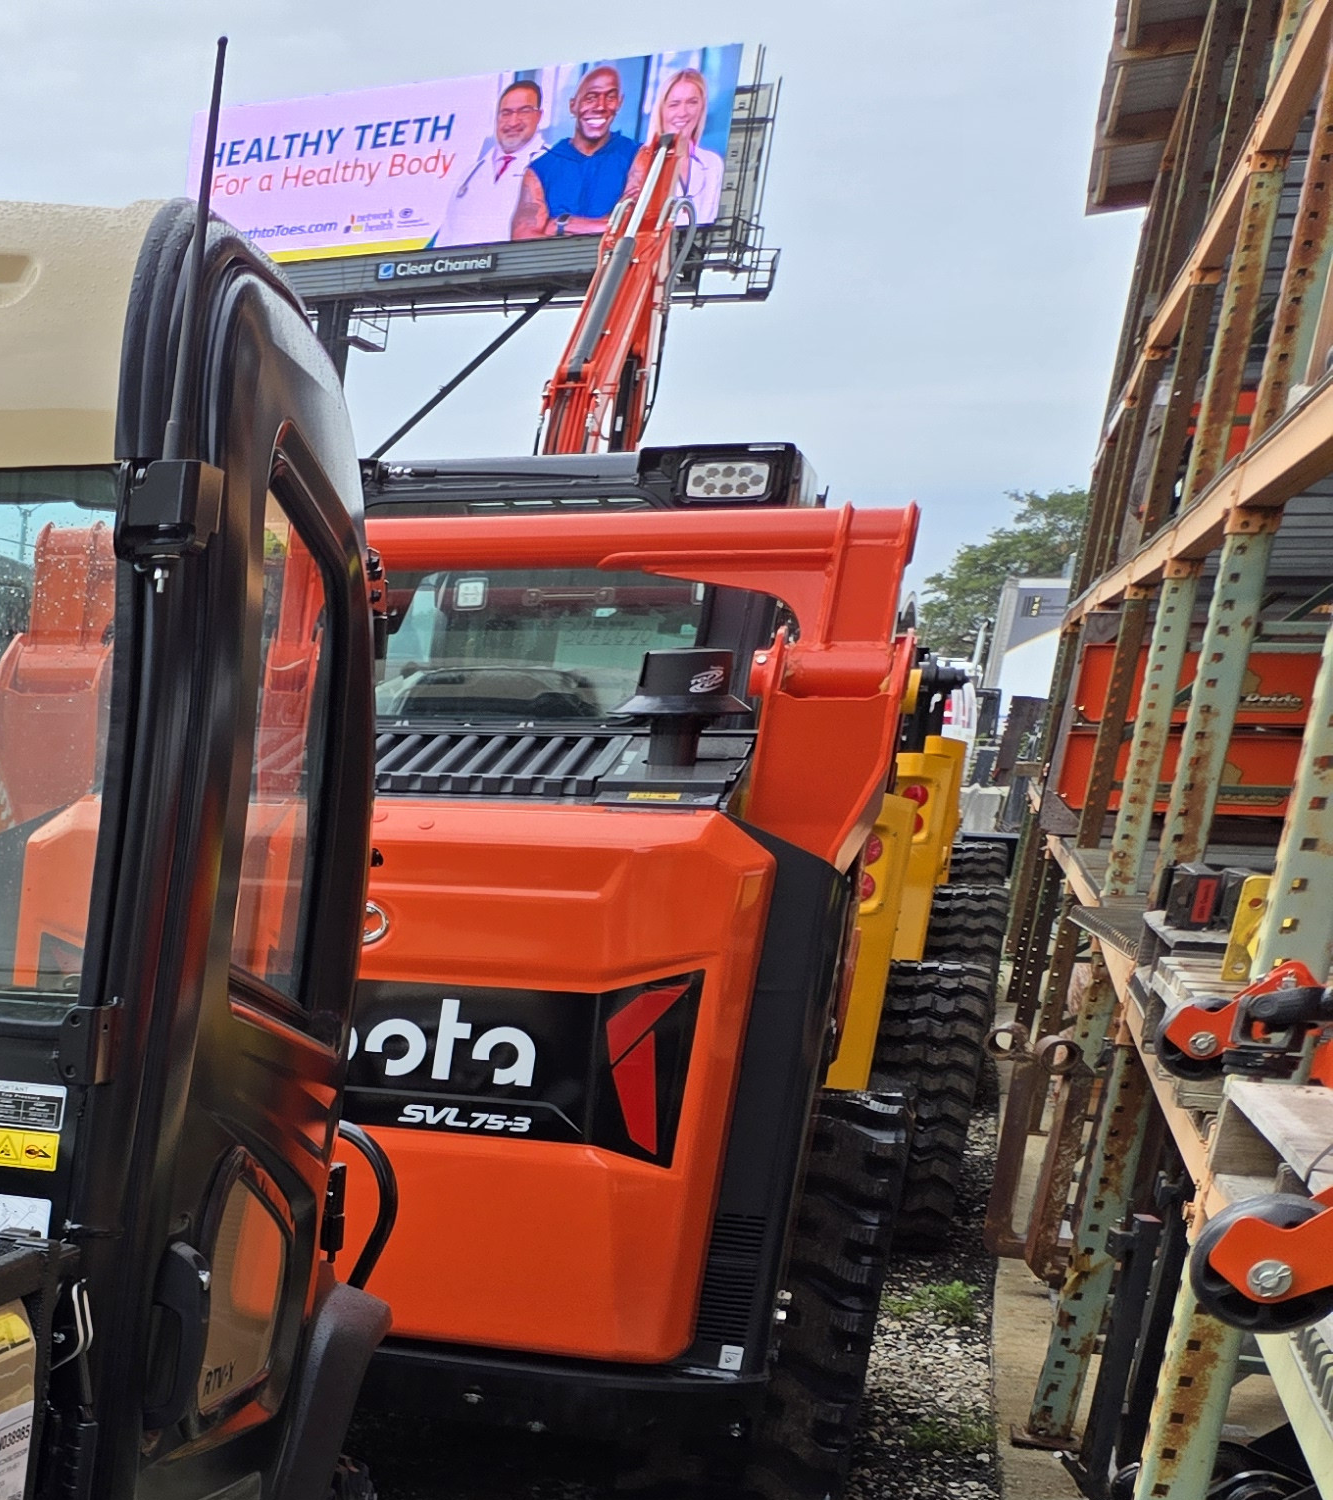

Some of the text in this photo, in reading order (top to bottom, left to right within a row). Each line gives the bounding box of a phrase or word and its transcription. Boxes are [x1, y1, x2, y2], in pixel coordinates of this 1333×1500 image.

[354, 113, 455, 150] TEETH
[212, 149, 455, 196] For a Healthy Body
[356, 209, 394, 222] network
[364, 221, 393, 233] health
[396, 256, 492, 276] Clear Channel
